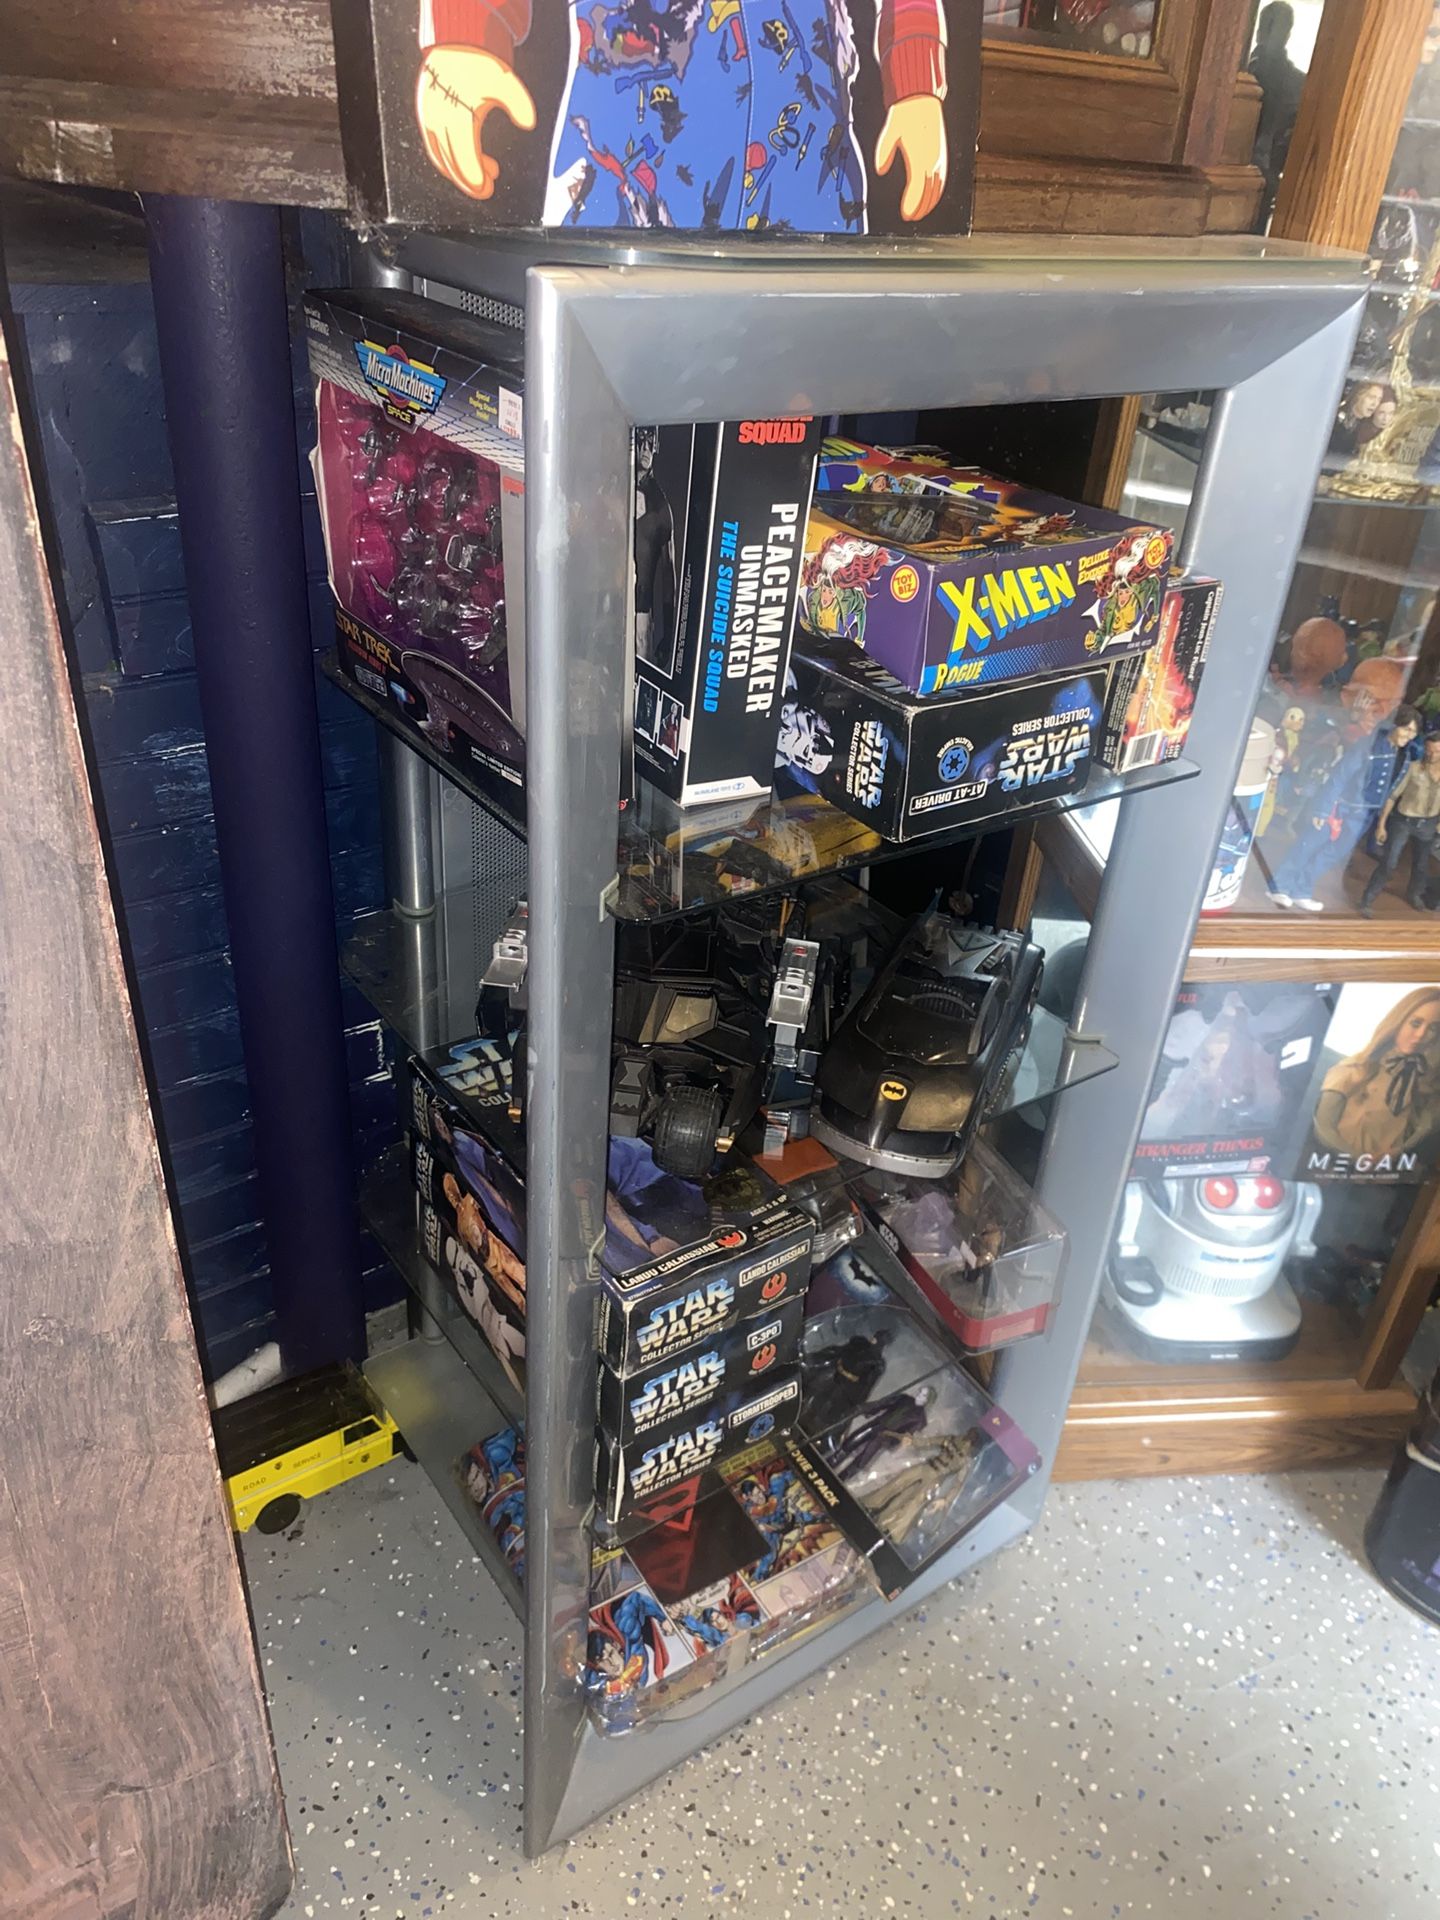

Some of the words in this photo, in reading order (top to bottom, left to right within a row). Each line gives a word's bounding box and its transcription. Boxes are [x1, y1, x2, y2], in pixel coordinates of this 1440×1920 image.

[387, 405, 412, 424] SPACE
[738, 421, 807, 445] SQUAD
[720, 521, 739, 561] THE
[1079, 548, 1112, 571] DELUXE
[1148, 543, 1161, 556] TOY
[894, 572, 914, 586] TOY
[898, 584, 914, 596] BIZ
[711, 564, 734, 646] SUICIDE
[726, 545, 764, 679] UNMASKED
[745, 503, 800, 713] PEACEMAKER
[937, 562, 1077, 653] X-MEN
[1203, 590, 1215, 620] Captain
[336, 609, 362, 645] STAR
[362, 630, 401, 675] TREK
[703, 649, 724, 713] SQUAD
[937, 659, 986, 692] ROGUE
[1012, 716, 1043, 736] SERIES
[1043, 706, 1091, 729] COLLECTOR
[848, 722, 861, 766] COLLECTOR
[853, 721, 877, 803] WARS
[1003, 724, 1091, 765] WARS
[846, 766, 856, 794] SERIES
[866, 721, 888, 809] STAR
[1000, 749, 1089, 791] STAR
[914, 788, 953, 811] DRIVER
[953, 781, 986, 802] AT-AT
[750, 1206, 768, 1217] AGES
[621, 1268, 658, 1289] LANDO
[742, 1264, 767, 1283] LANDO
[766, 1245, 807, 1272] CALRISSIAN
[637, 1278, 736, 1335] STAR
[637, 1296, 735, 1352] WARS
[640, 1337, 692, 1364] COLLECTOR
[692, 1321, 724, 1340] SERIES
[751, 1326, 778, 1346] C-3PO
[630, 1351, 726, 1408] STAR
[630, 1367, 726, 1423] WARS
[635, 1407, 682, 1435] COLLECTOR
[682, 1391, 714, 1414] SERIES
[732, 1386, 795, 1425] STORMTROOPER
[630, 1420, 723, 1477] STAR
[630, 1435, 722, 1491] WARS
[242, 1476, 267, 1491] ROAD
[634, 1473, 681, 1500] COLLECTOR
[681, 1457, 712, 1479] SERIES
[785, 1440, 813, 1472] MOVIE
[808, 1469, 818, 1480] 3
[814, 1478, 840, 1507] PACK
